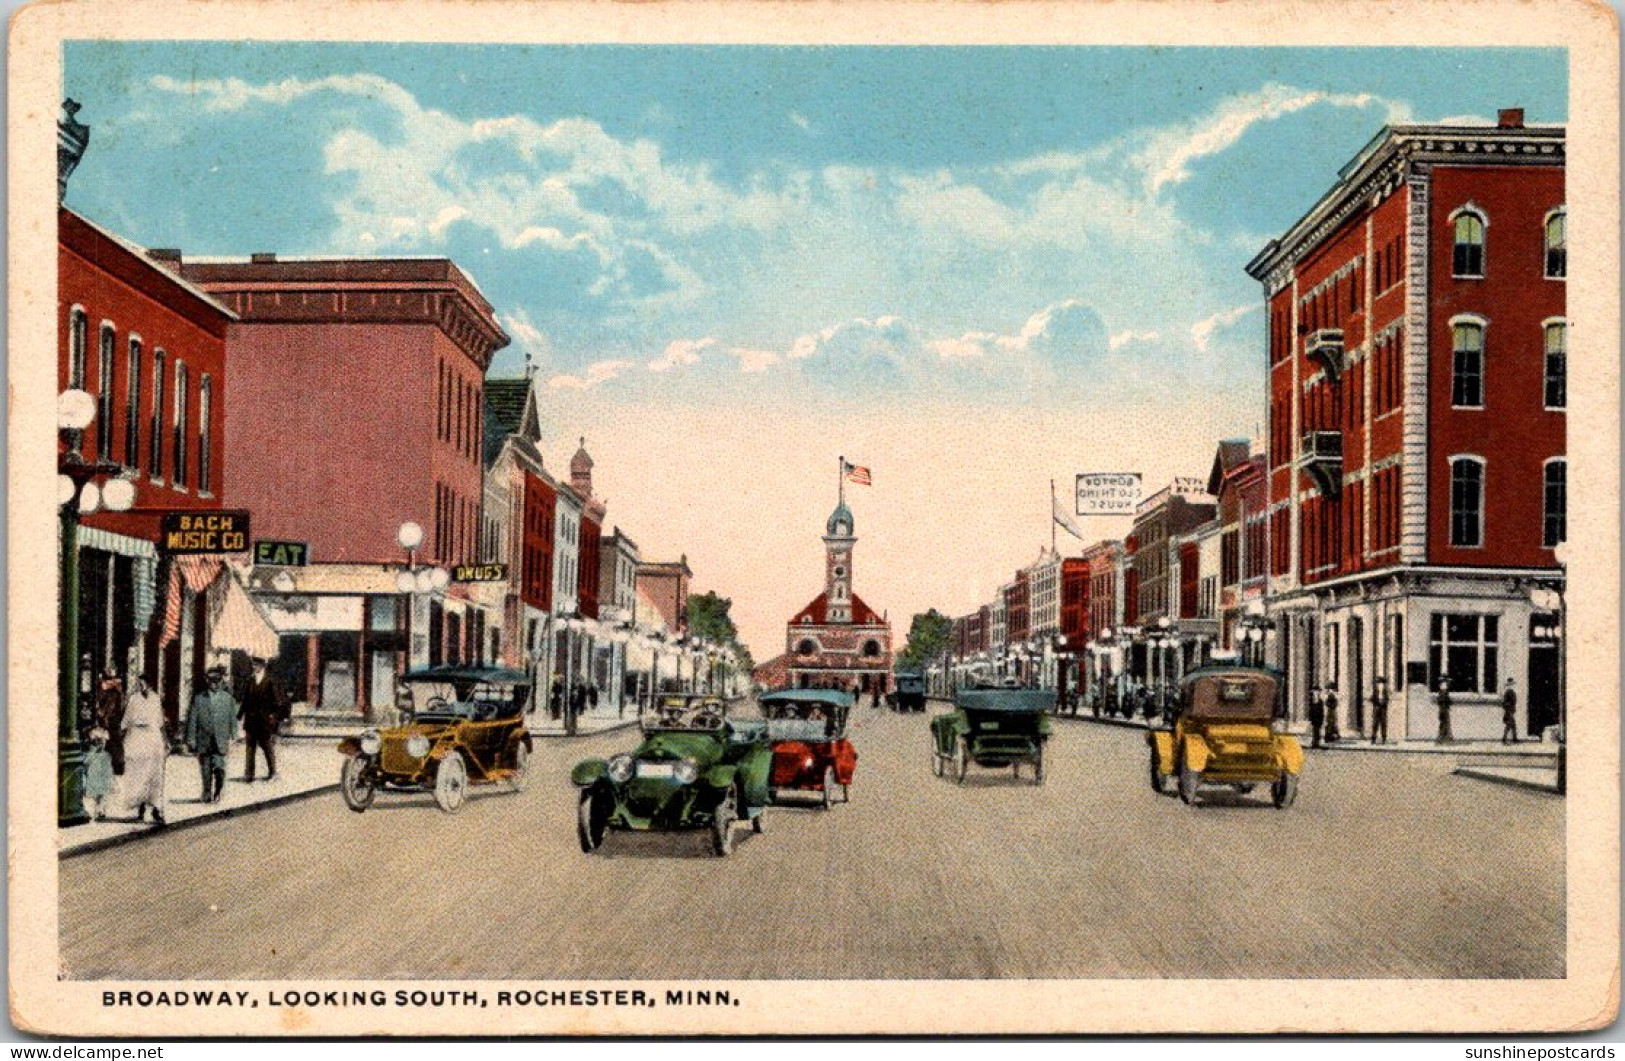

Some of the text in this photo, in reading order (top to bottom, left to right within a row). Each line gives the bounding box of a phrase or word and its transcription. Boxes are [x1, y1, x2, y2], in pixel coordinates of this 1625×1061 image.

[180, 516, 233, 530] BACH
[167, 531, 244, 549] MUSIC CO
[258, 542, 304, 564] EAT
[456, 566, 502, 580] DRUGS
